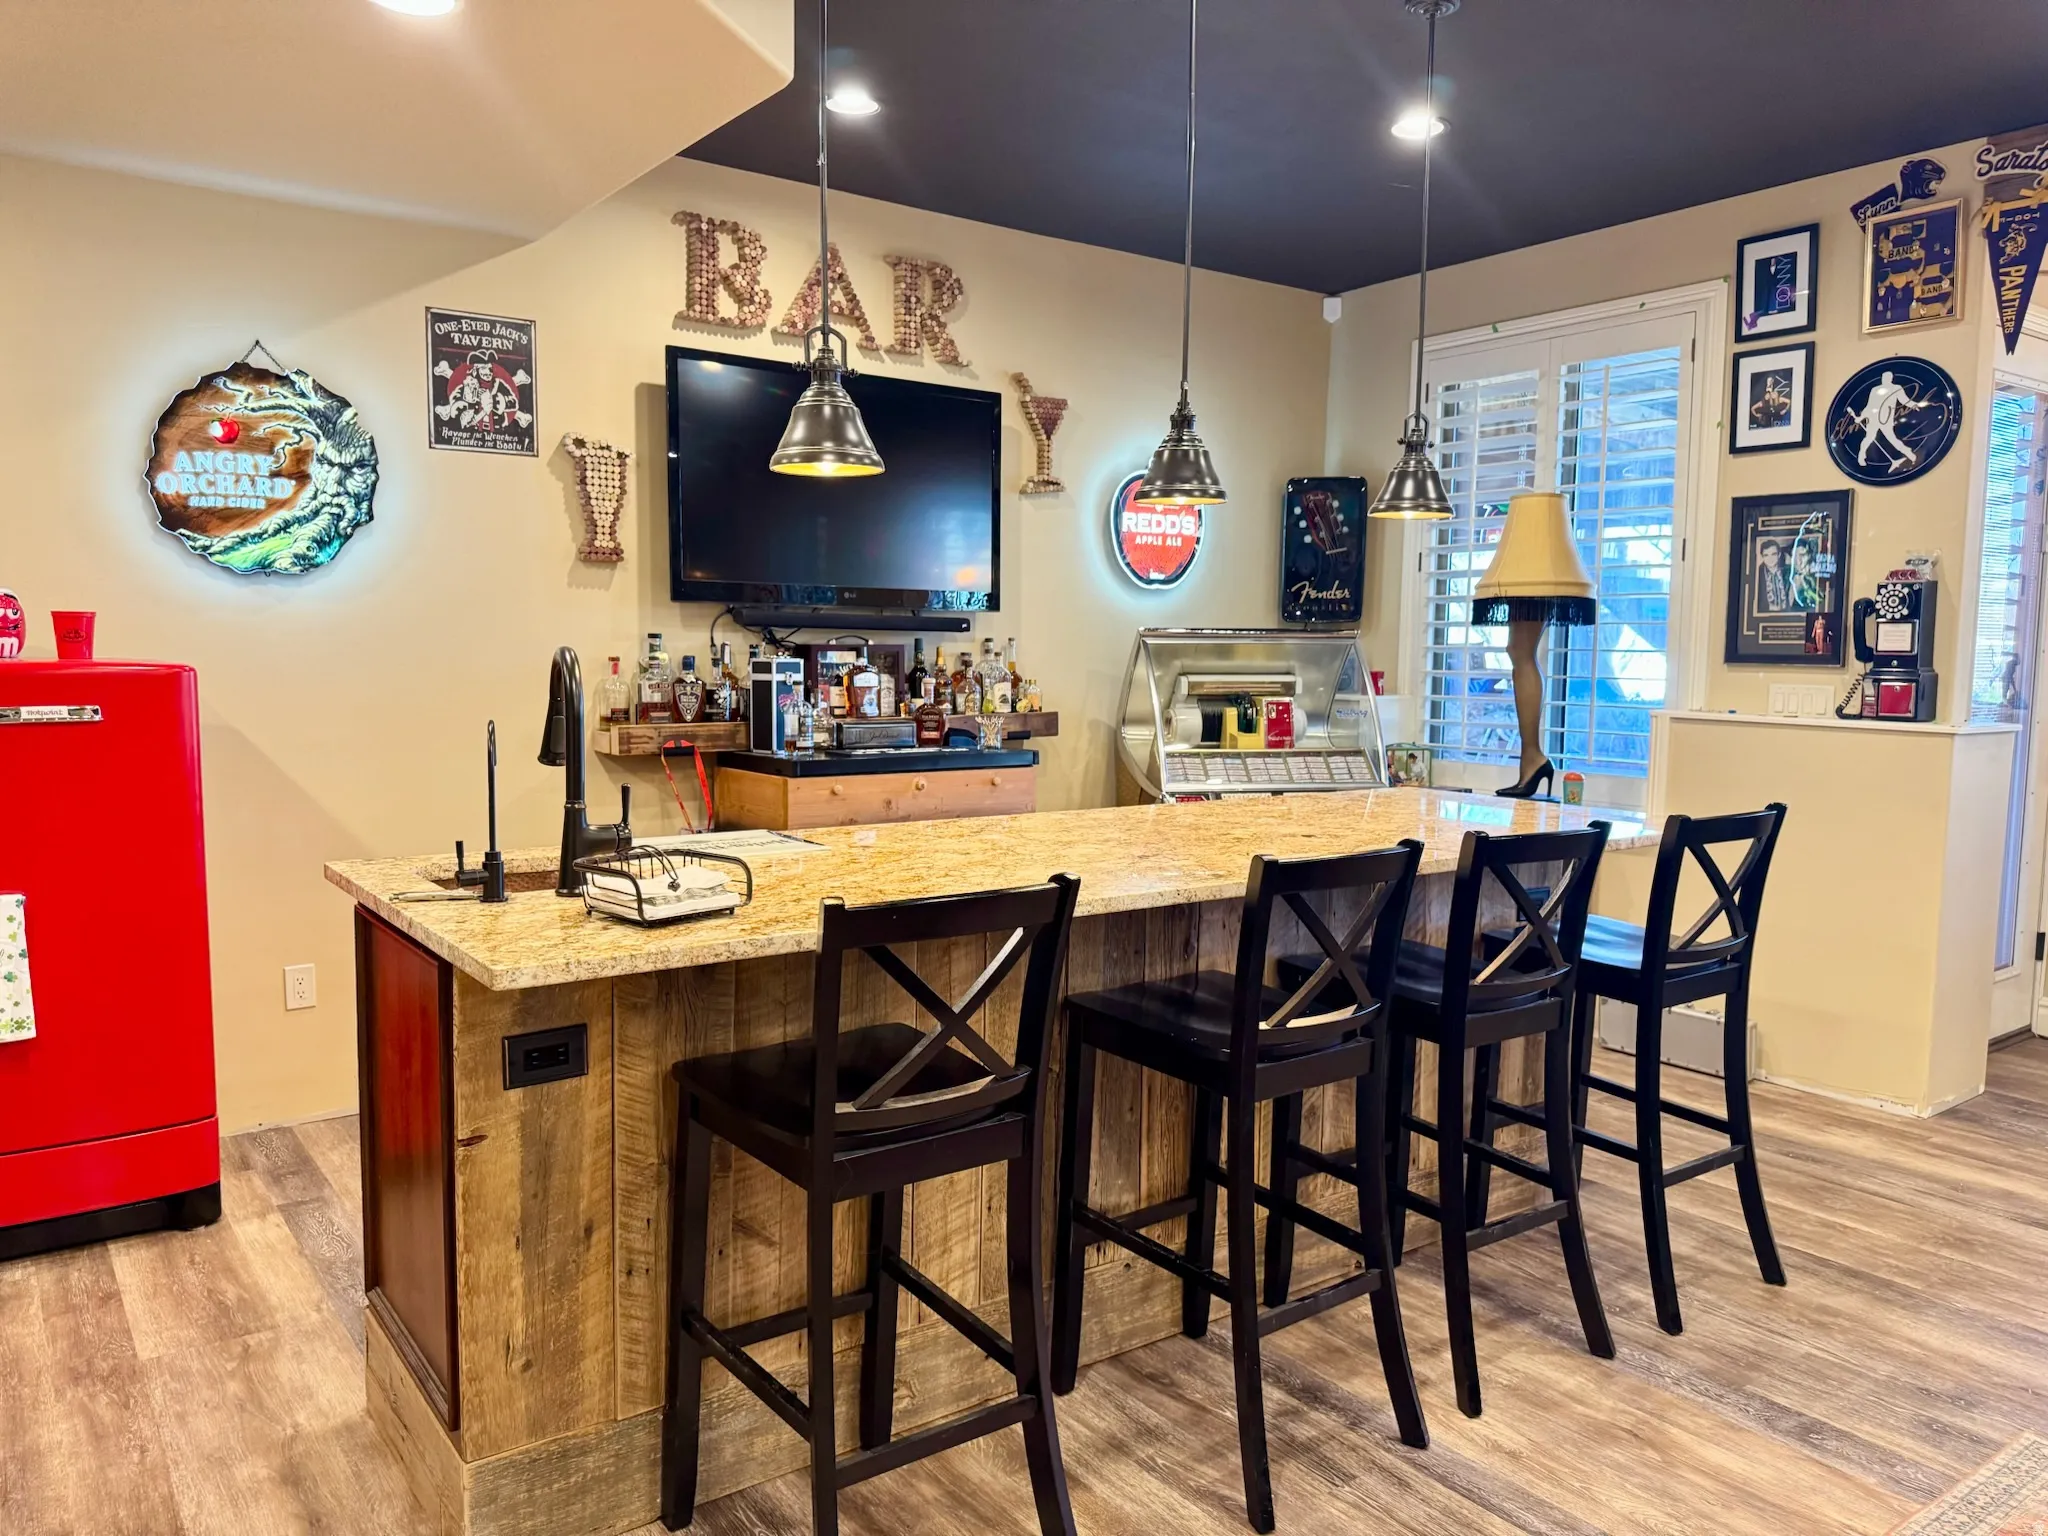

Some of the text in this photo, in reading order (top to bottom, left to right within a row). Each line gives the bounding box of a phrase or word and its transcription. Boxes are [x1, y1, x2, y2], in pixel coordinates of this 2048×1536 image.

[1976, 142, 2048, 187] Sarato
[1888, 245, 1914, 259] BAND
[671, 210, 972, 367] BAR
[1999, 264, 2028, 334] PANTHERS
[434, 319, 528, 344] ONE-EYED JACK'S
[451, 333, 513, 350] TAVERN
[174, 451, 274, 476] ANGRY
[155, 472, 293, 499] ORCHARD
[1135, 535, 1182, 547] APPLE ALE
[1291, 580, 1351, 604] Fender
